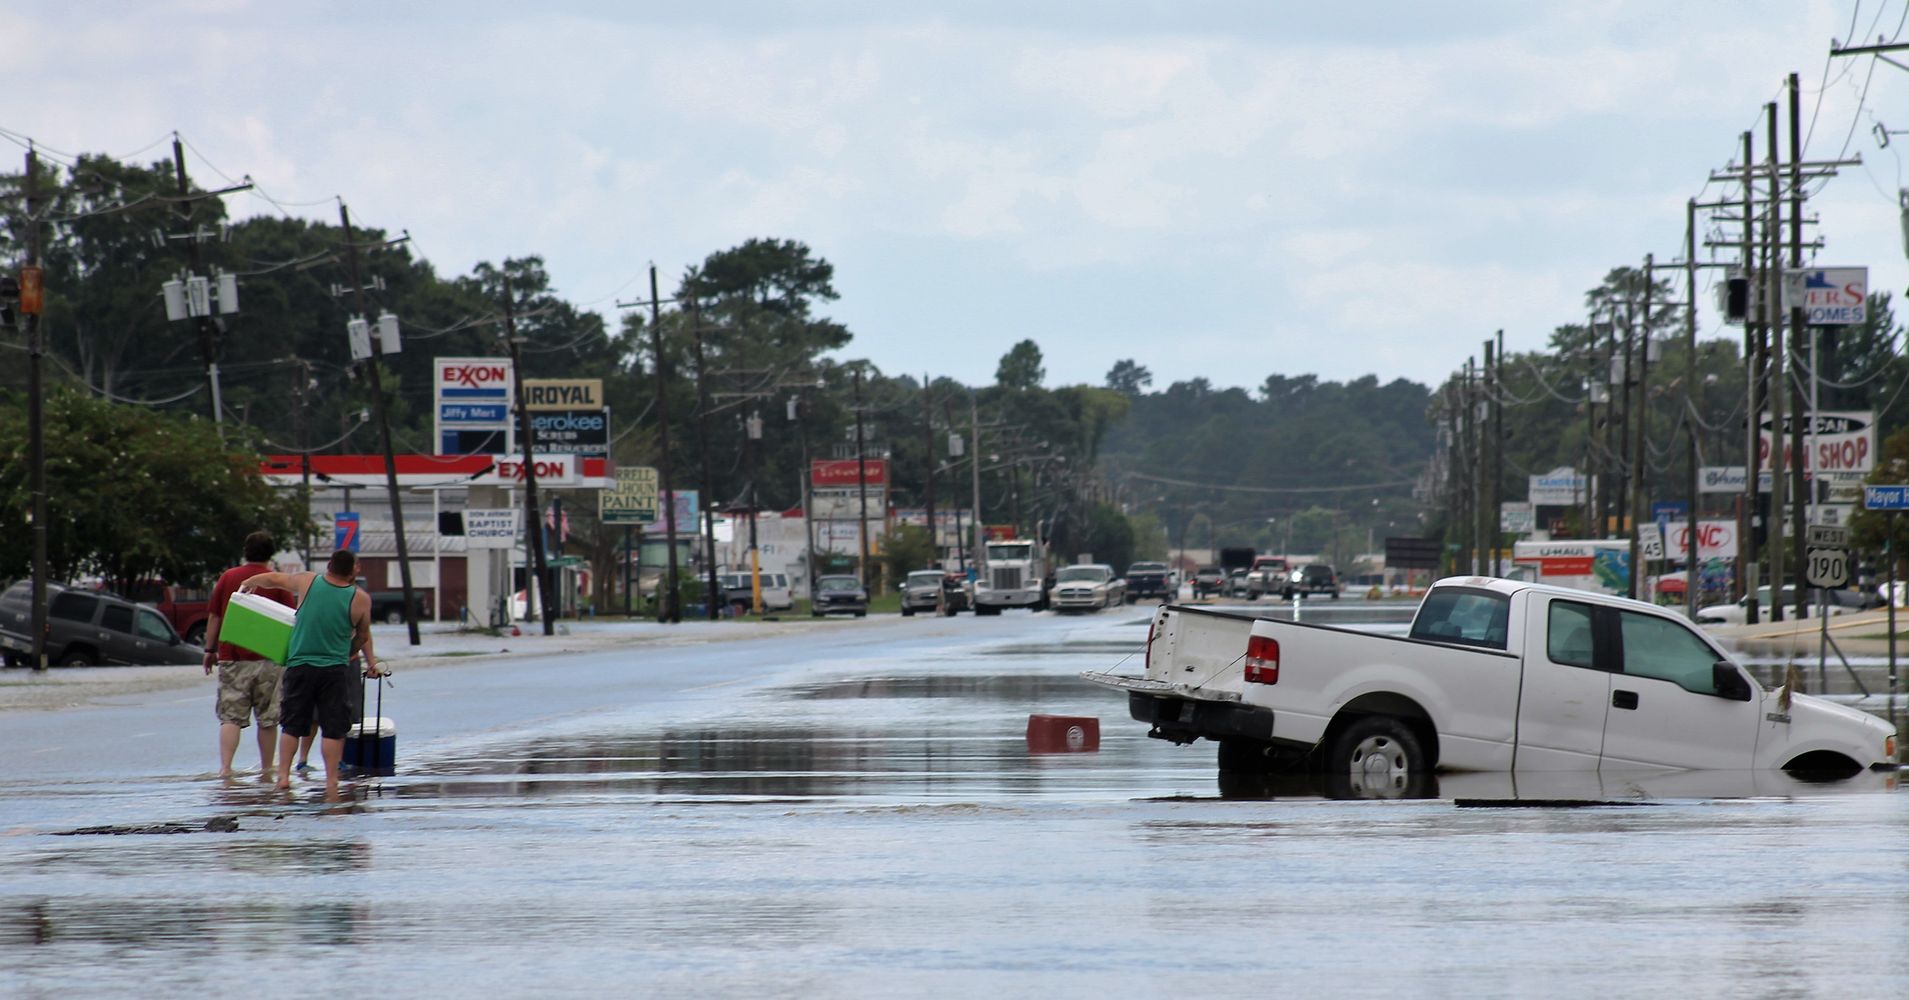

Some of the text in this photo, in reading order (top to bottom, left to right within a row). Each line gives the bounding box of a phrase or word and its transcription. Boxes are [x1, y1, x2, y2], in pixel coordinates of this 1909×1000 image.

[1804, 281, 1863, 307] ERS
[443, 365, 505, 388] EXXON
[525, 386, 595, 405] IROYAL
[442, 408, 496, 420] Jiffy Mart
[1819, 436, 1868, 469] SHOP
[602, 495, 655, 509] PAINT
[1867, 488, 1899, 507] Mayor
[469, 520, 512, 529] BAPTIST
[336, 520, 359, 549] 7
[469, 529, 513, 538] CHURCH
[1813, 530, 1845, 542] WEST
[1540, 547, 1588, 557] U-HAUL
[1645, 542, 1661, 557] 45
[1812, 557, 1842, 580] 190
